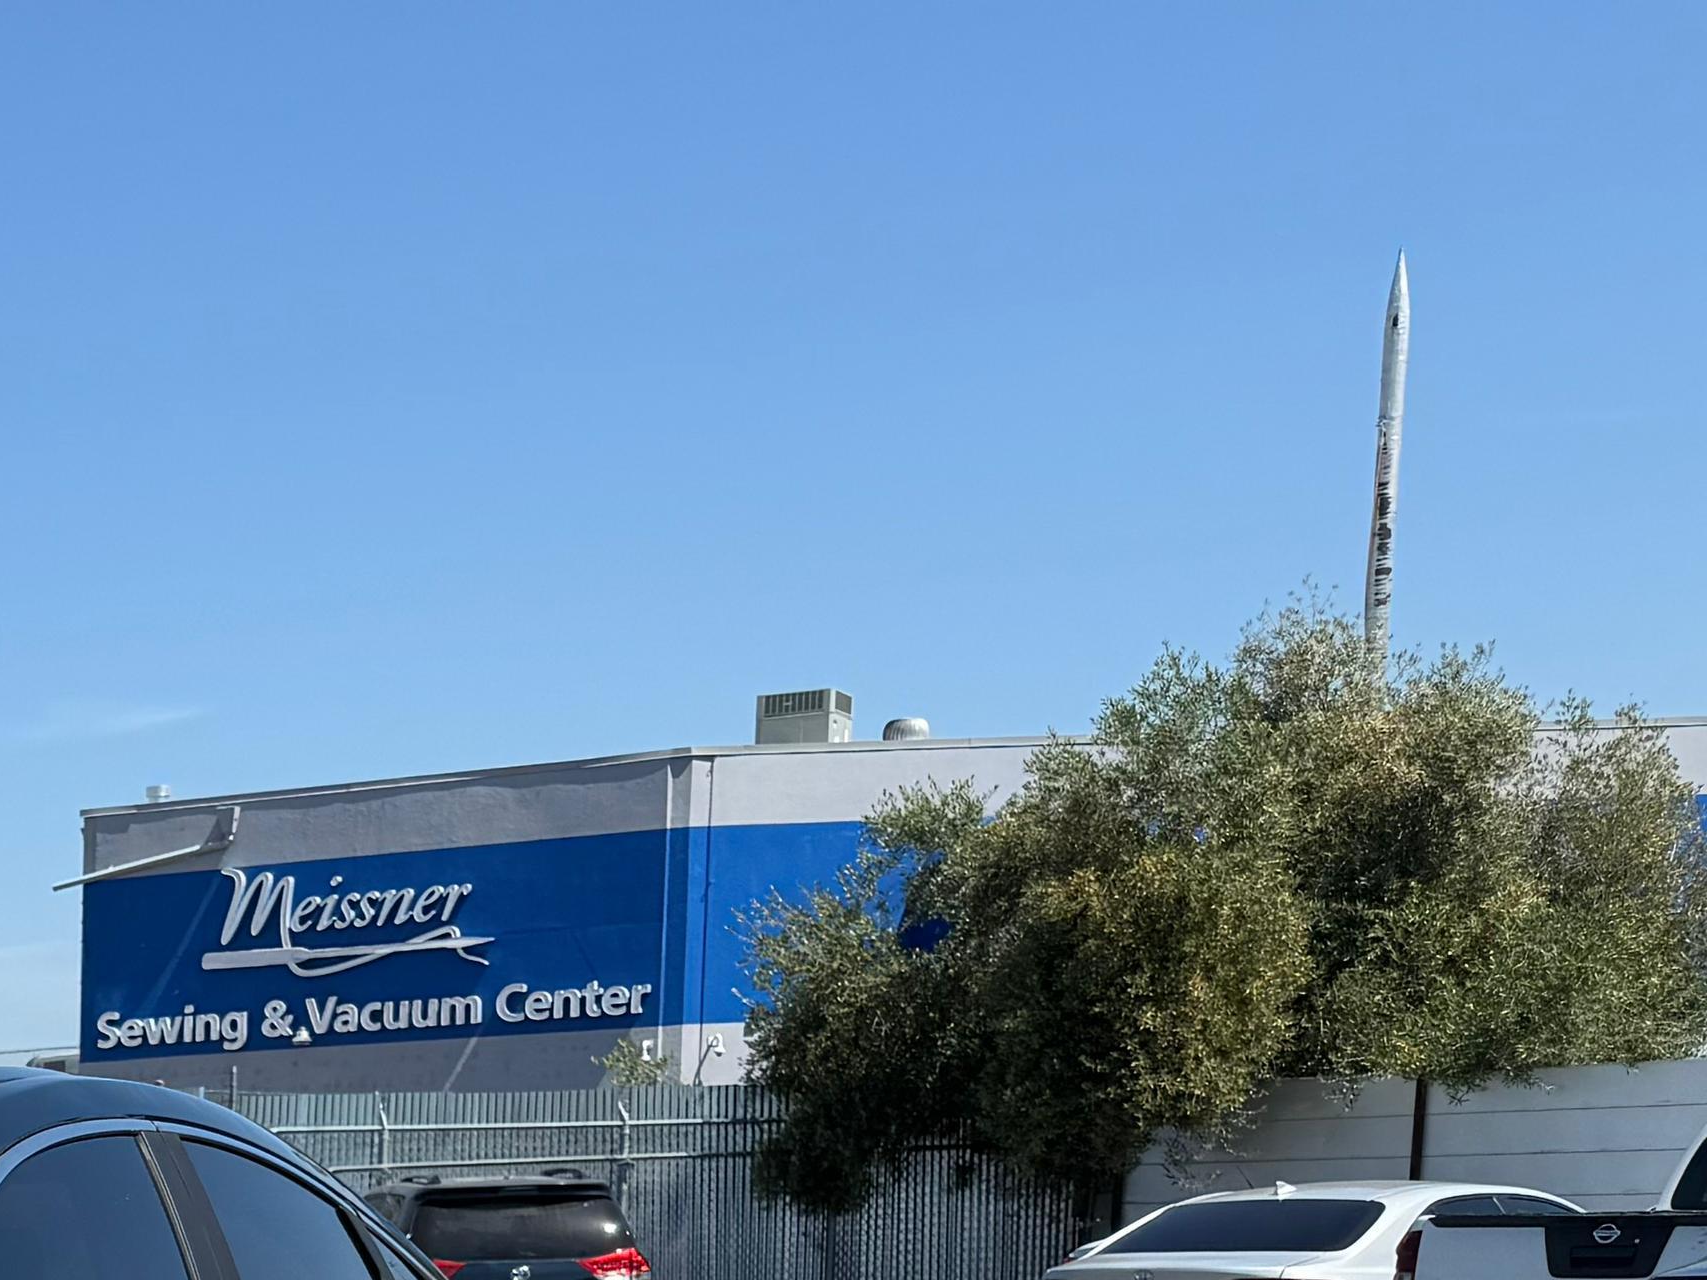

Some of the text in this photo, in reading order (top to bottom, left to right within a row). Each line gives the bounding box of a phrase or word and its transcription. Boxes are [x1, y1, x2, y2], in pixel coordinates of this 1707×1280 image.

[220, 867, 473, 948] Meissner
[96, 980, 652, 1050] Sewing & Vacuum Center
